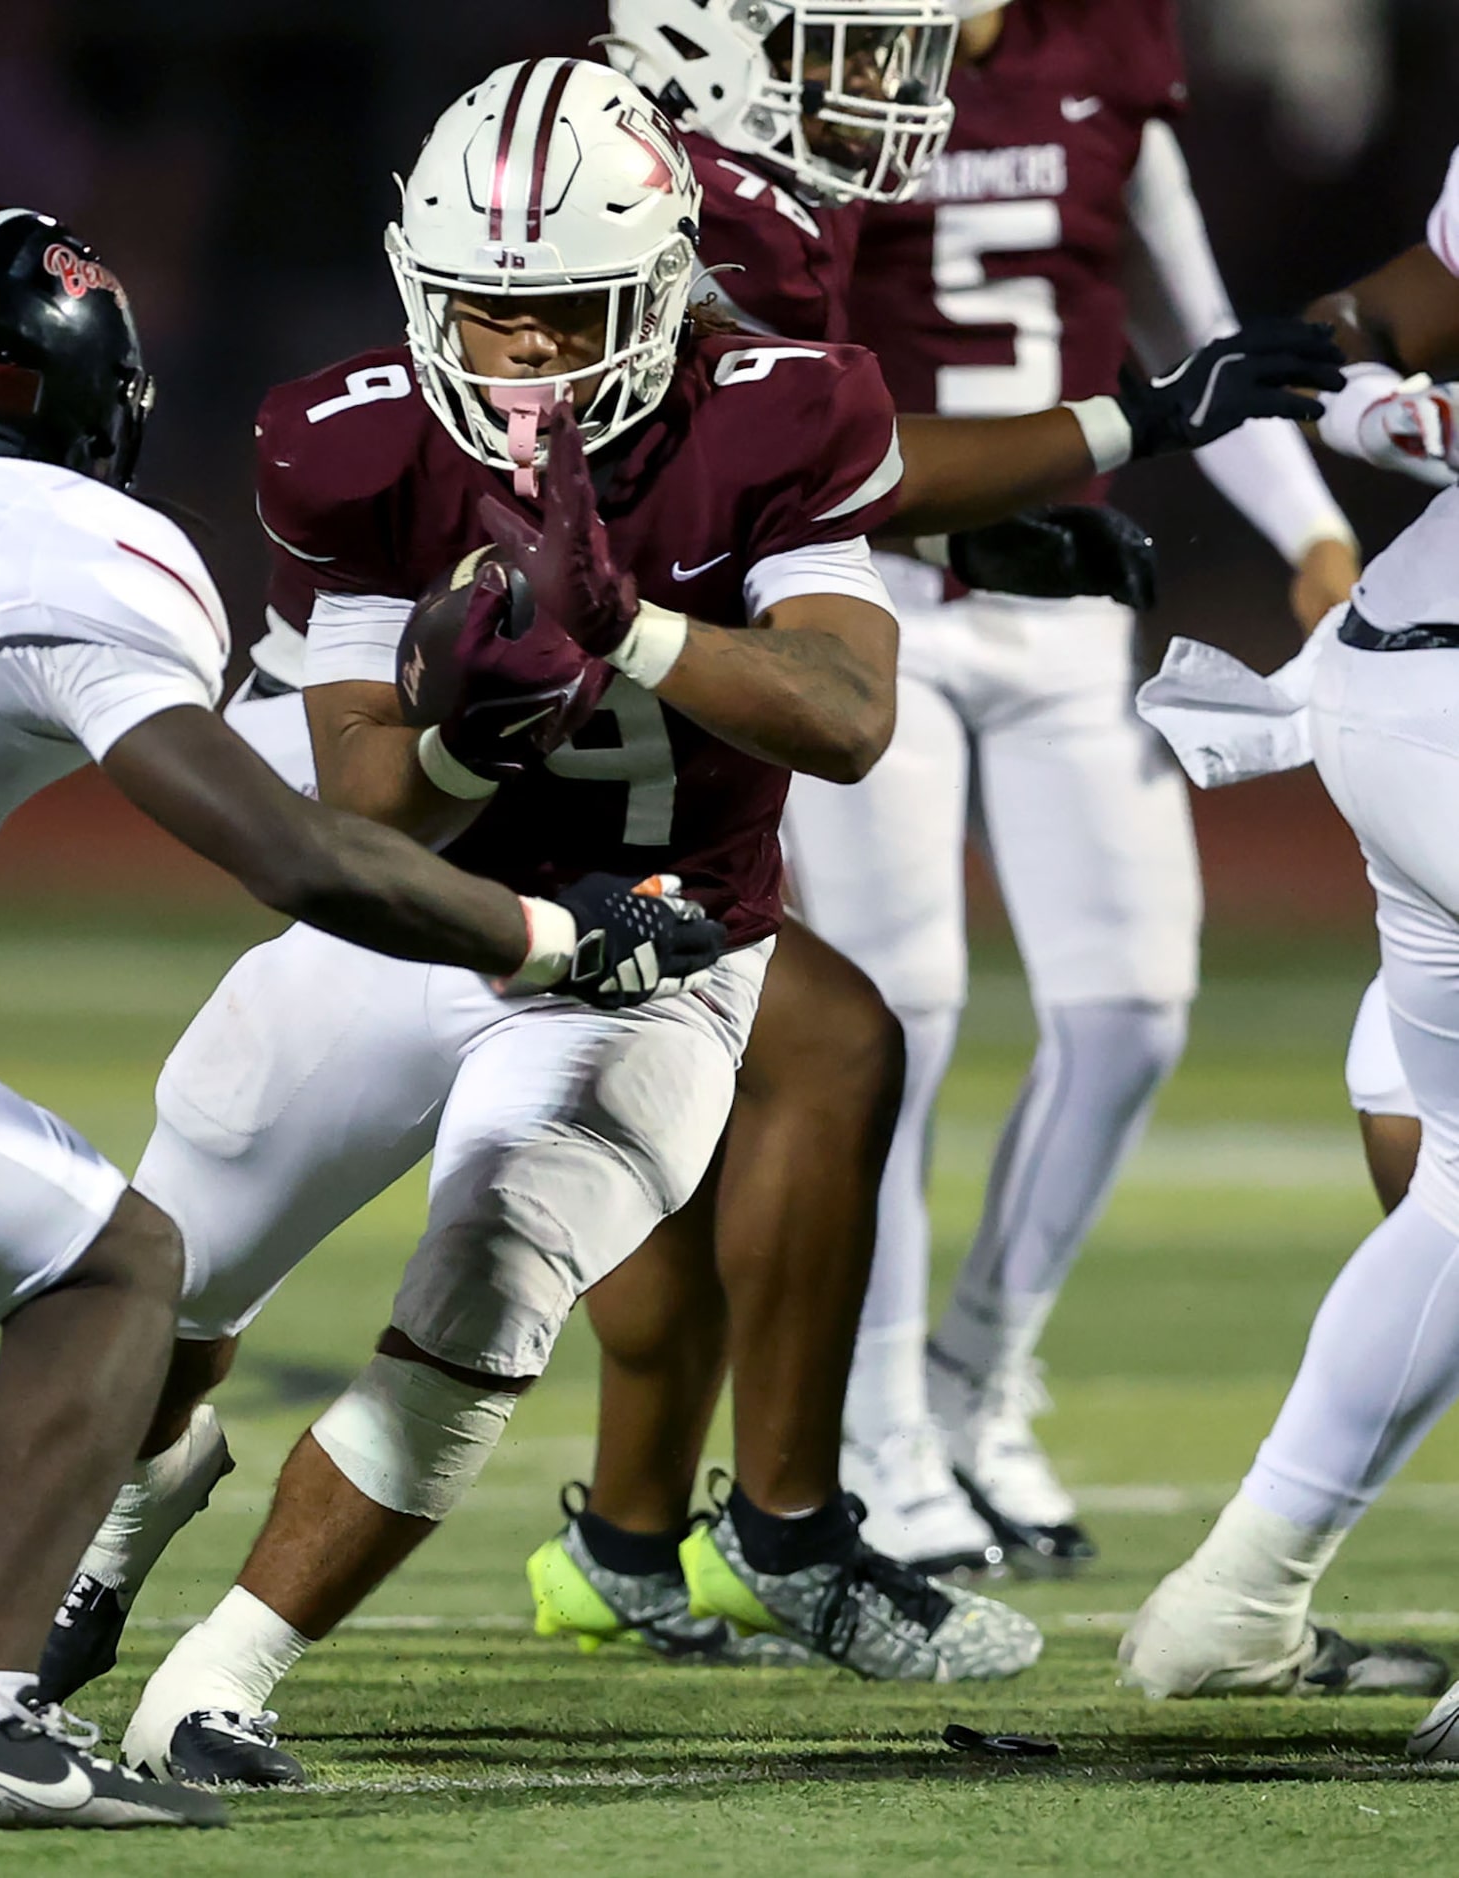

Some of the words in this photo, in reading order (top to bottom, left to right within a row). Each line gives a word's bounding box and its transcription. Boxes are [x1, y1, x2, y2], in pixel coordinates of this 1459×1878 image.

[714, 346, 828, 387] 9
[933, 199, 1062, 416] 5
[306, 362, 411, 424] 9
[545, 672, 678, 846] 9
